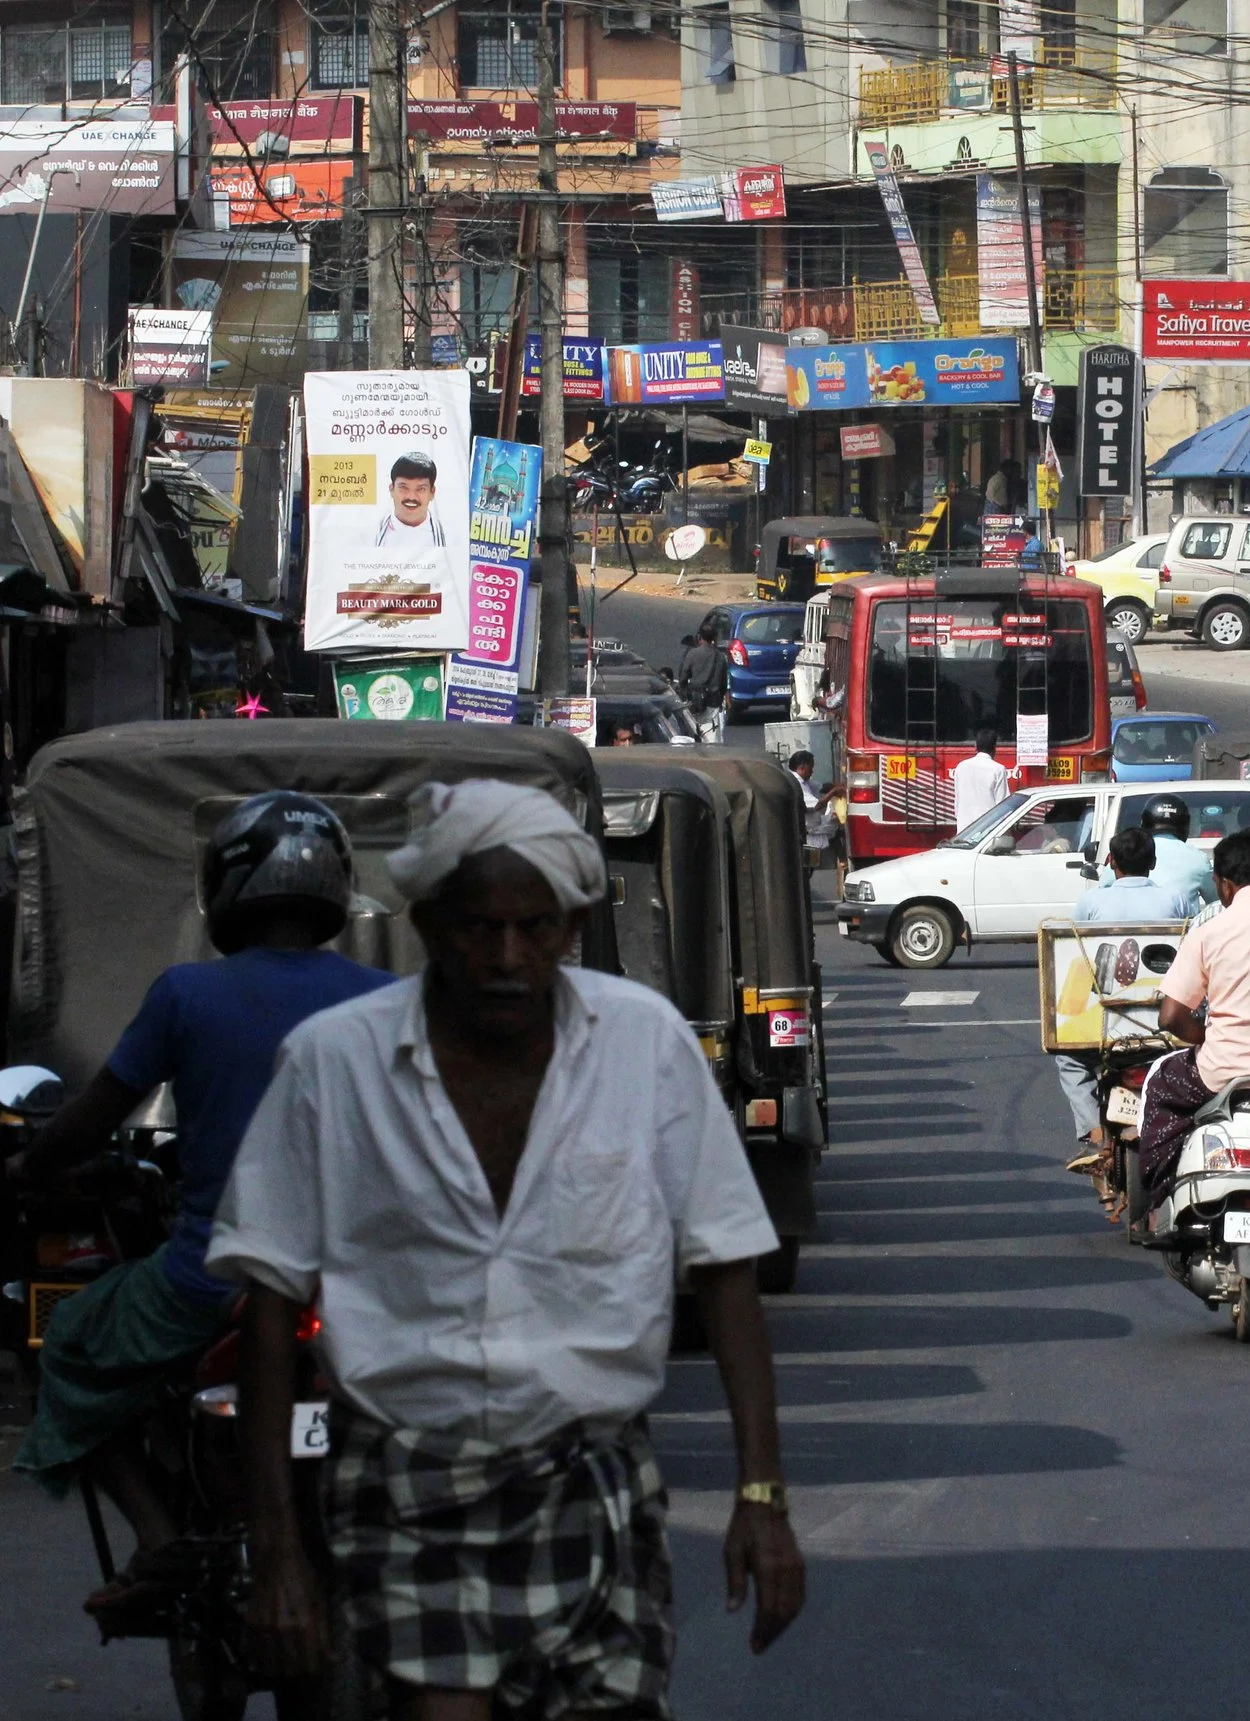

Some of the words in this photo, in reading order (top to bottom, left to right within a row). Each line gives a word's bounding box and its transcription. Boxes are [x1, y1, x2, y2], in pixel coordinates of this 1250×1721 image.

[297, 104, 318, 118] बैंक
[1157, 313, 1206, 335] Safiya
[934, 354, 1004, 371] Orange
[1091, 352, 1130, 365] HARITHA
[644, 351, 686, 381] UNITY
[356, 382, 420, 393] സുതാര്യമായ
[399, 407, 441, 417] ഗോൾഡ്
[331, 420, 448, 443] മണ്ണാർക്കാടും
[1095, 377, 1123, 486] HOTEL
[334, 462, 354, 471] 2013
[319, 474, 368, 484] നവംബർ
[317, 489, 327, 497] 21
[330, 488, 365, 501] മുതൽ
[341, 599, 378, 608] BEAUTY
[381, 599, 409, 608] MARK
[410, 599, 438, 609] GOLD
[890, 761, 912, 774] STOP
[775, 1021, 788, 1031] 68
